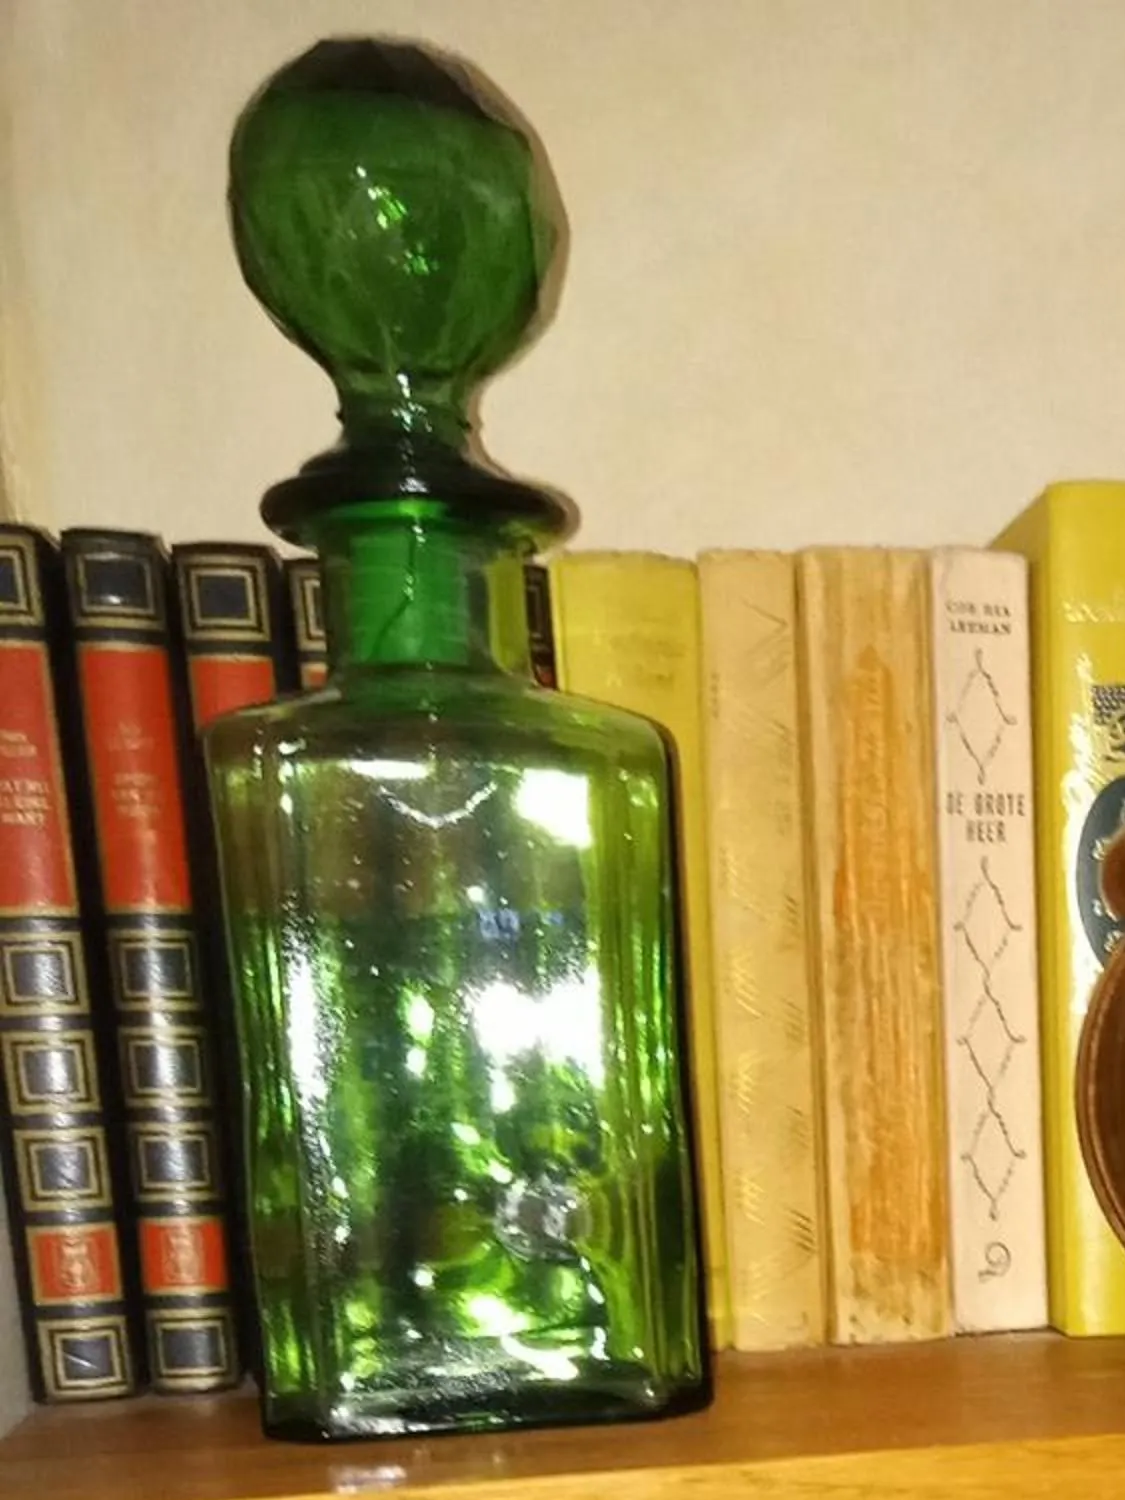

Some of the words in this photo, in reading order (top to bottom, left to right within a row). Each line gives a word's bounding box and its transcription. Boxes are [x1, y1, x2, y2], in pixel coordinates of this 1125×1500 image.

[945, 790, 966, 817] DE
[974, 791, 1026, 818] GROTE
[964, 819, 1007, 844] HEER
